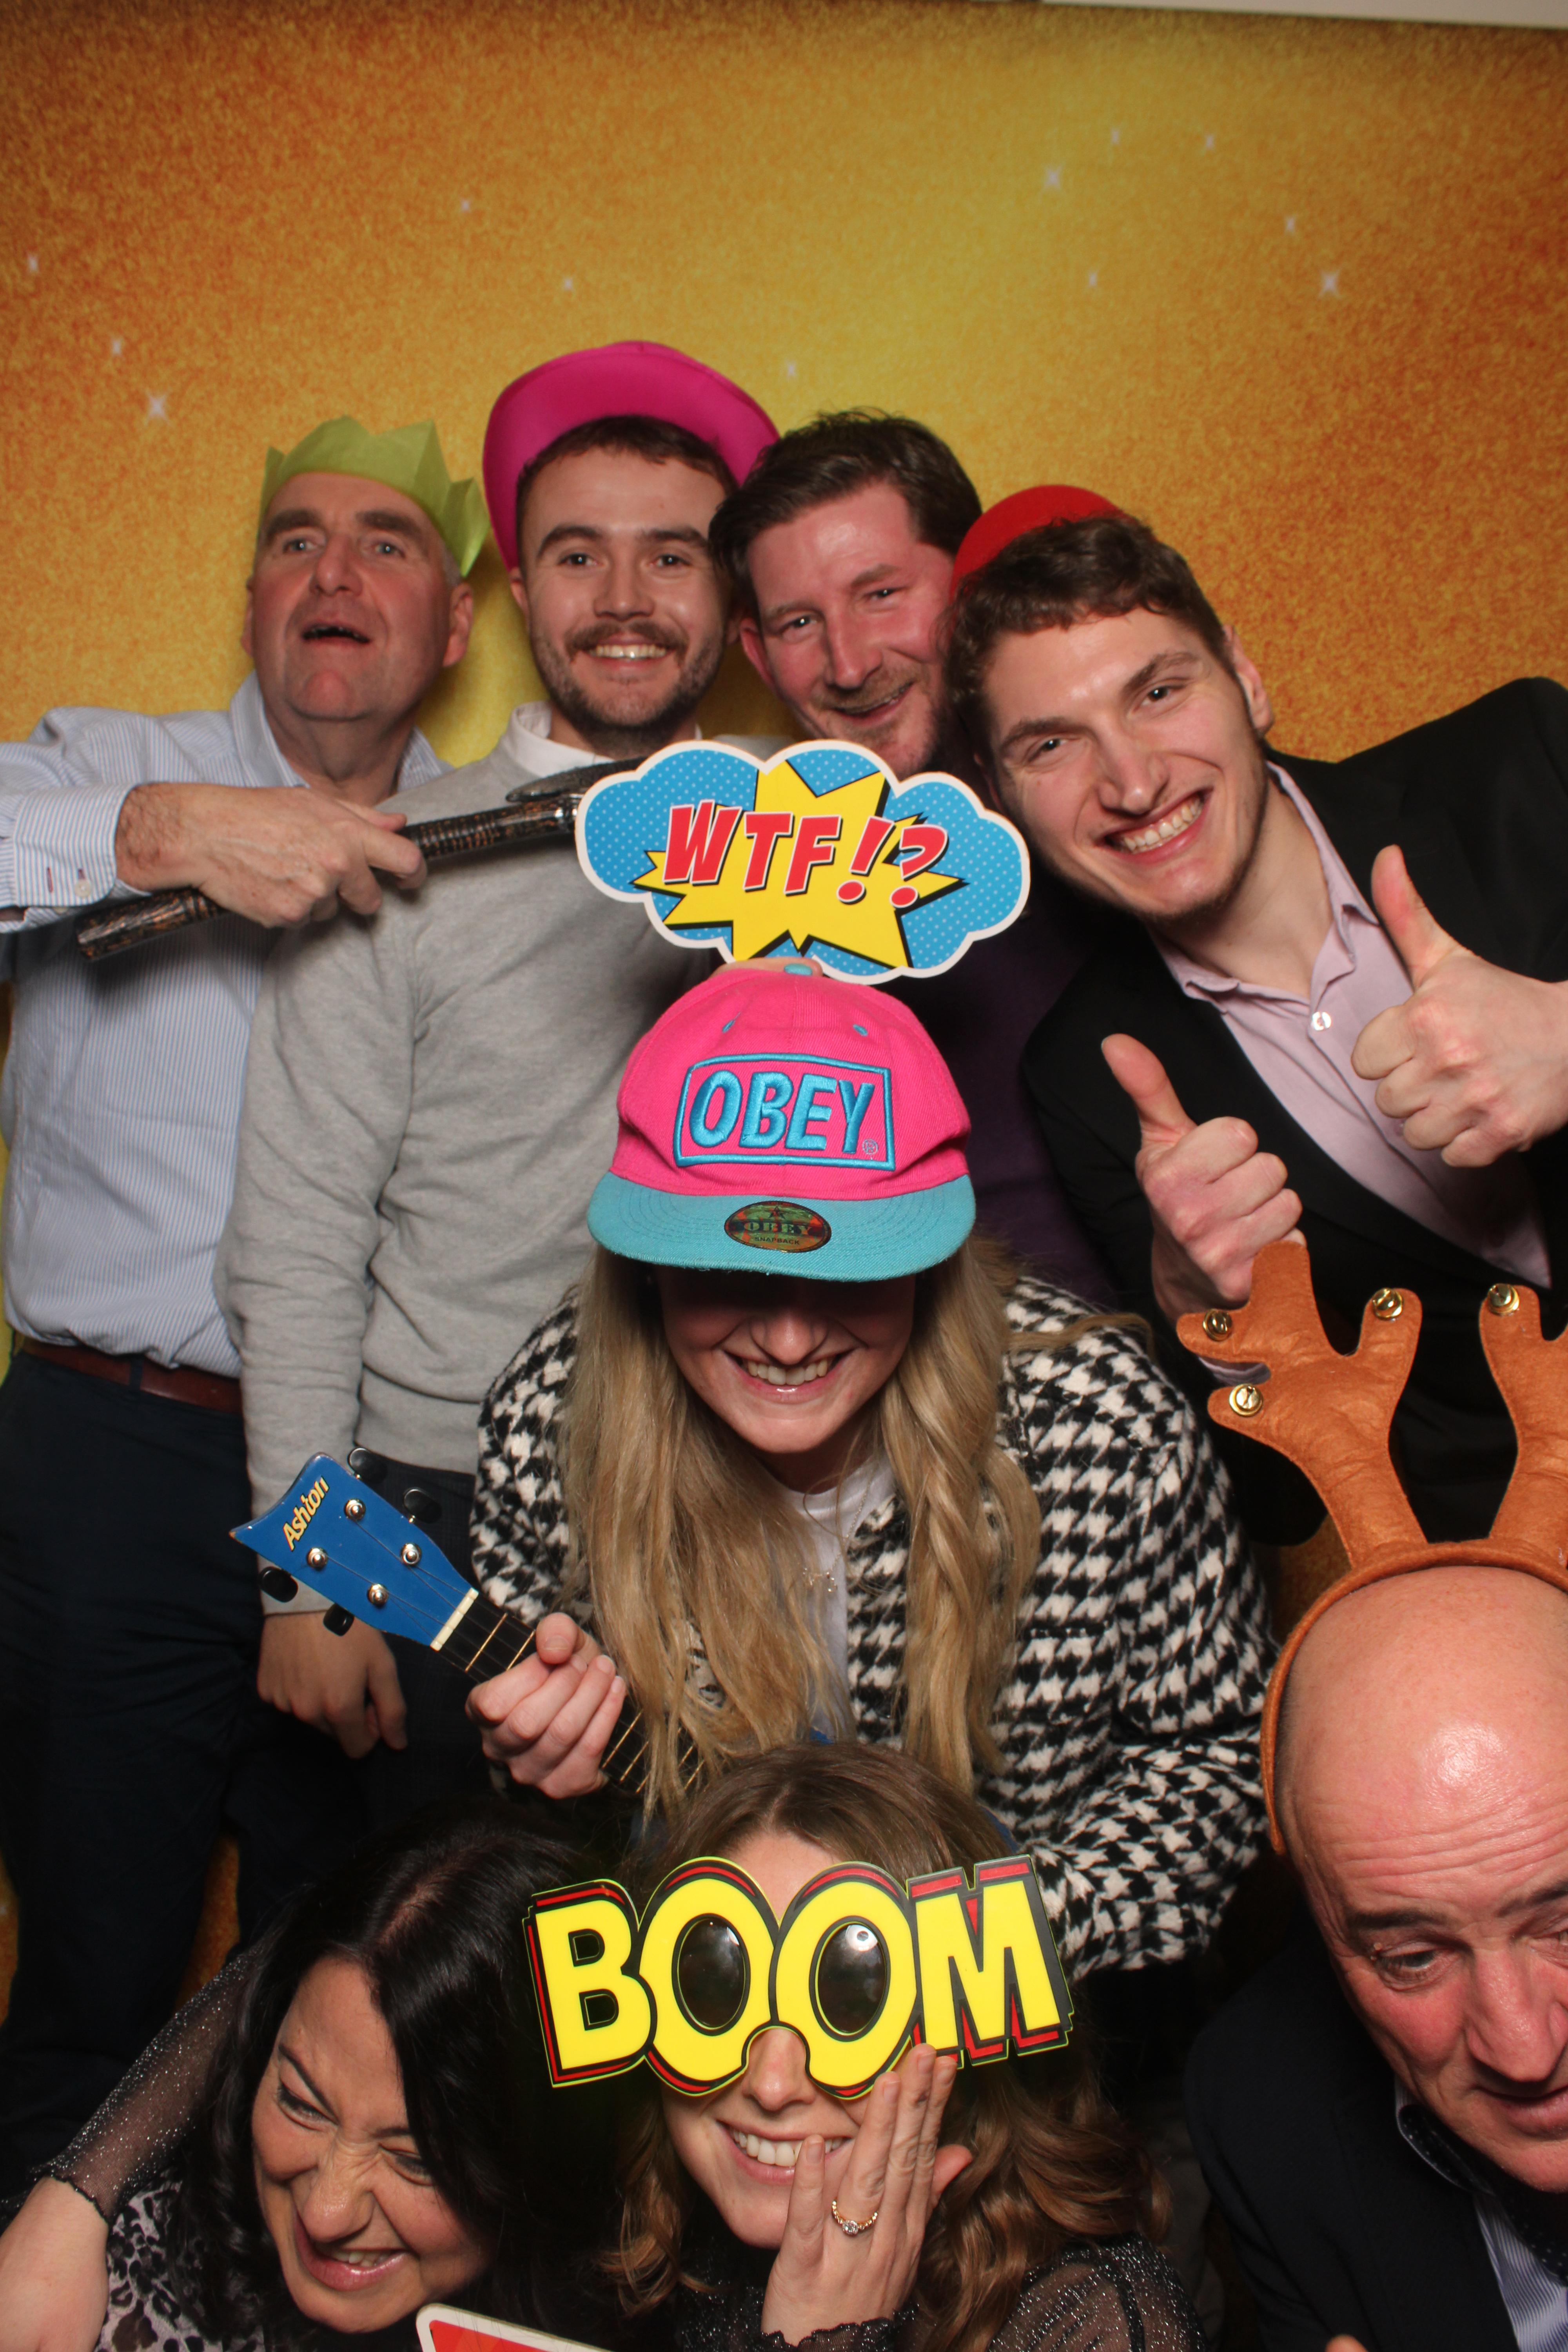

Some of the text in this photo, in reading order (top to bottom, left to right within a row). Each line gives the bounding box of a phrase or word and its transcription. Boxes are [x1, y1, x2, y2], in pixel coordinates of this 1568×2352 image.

[662, 799, 949, 909] WTF!?
[689, 1070, 875, 1154] OBEY
[744, 1221, 812, 1236] OBEY
[754, 1236, 800, 1245] SNAPBACK
[282, 1475, 330, 1552] Ashton
[529, 1860, 1068, 2095] BOOM
